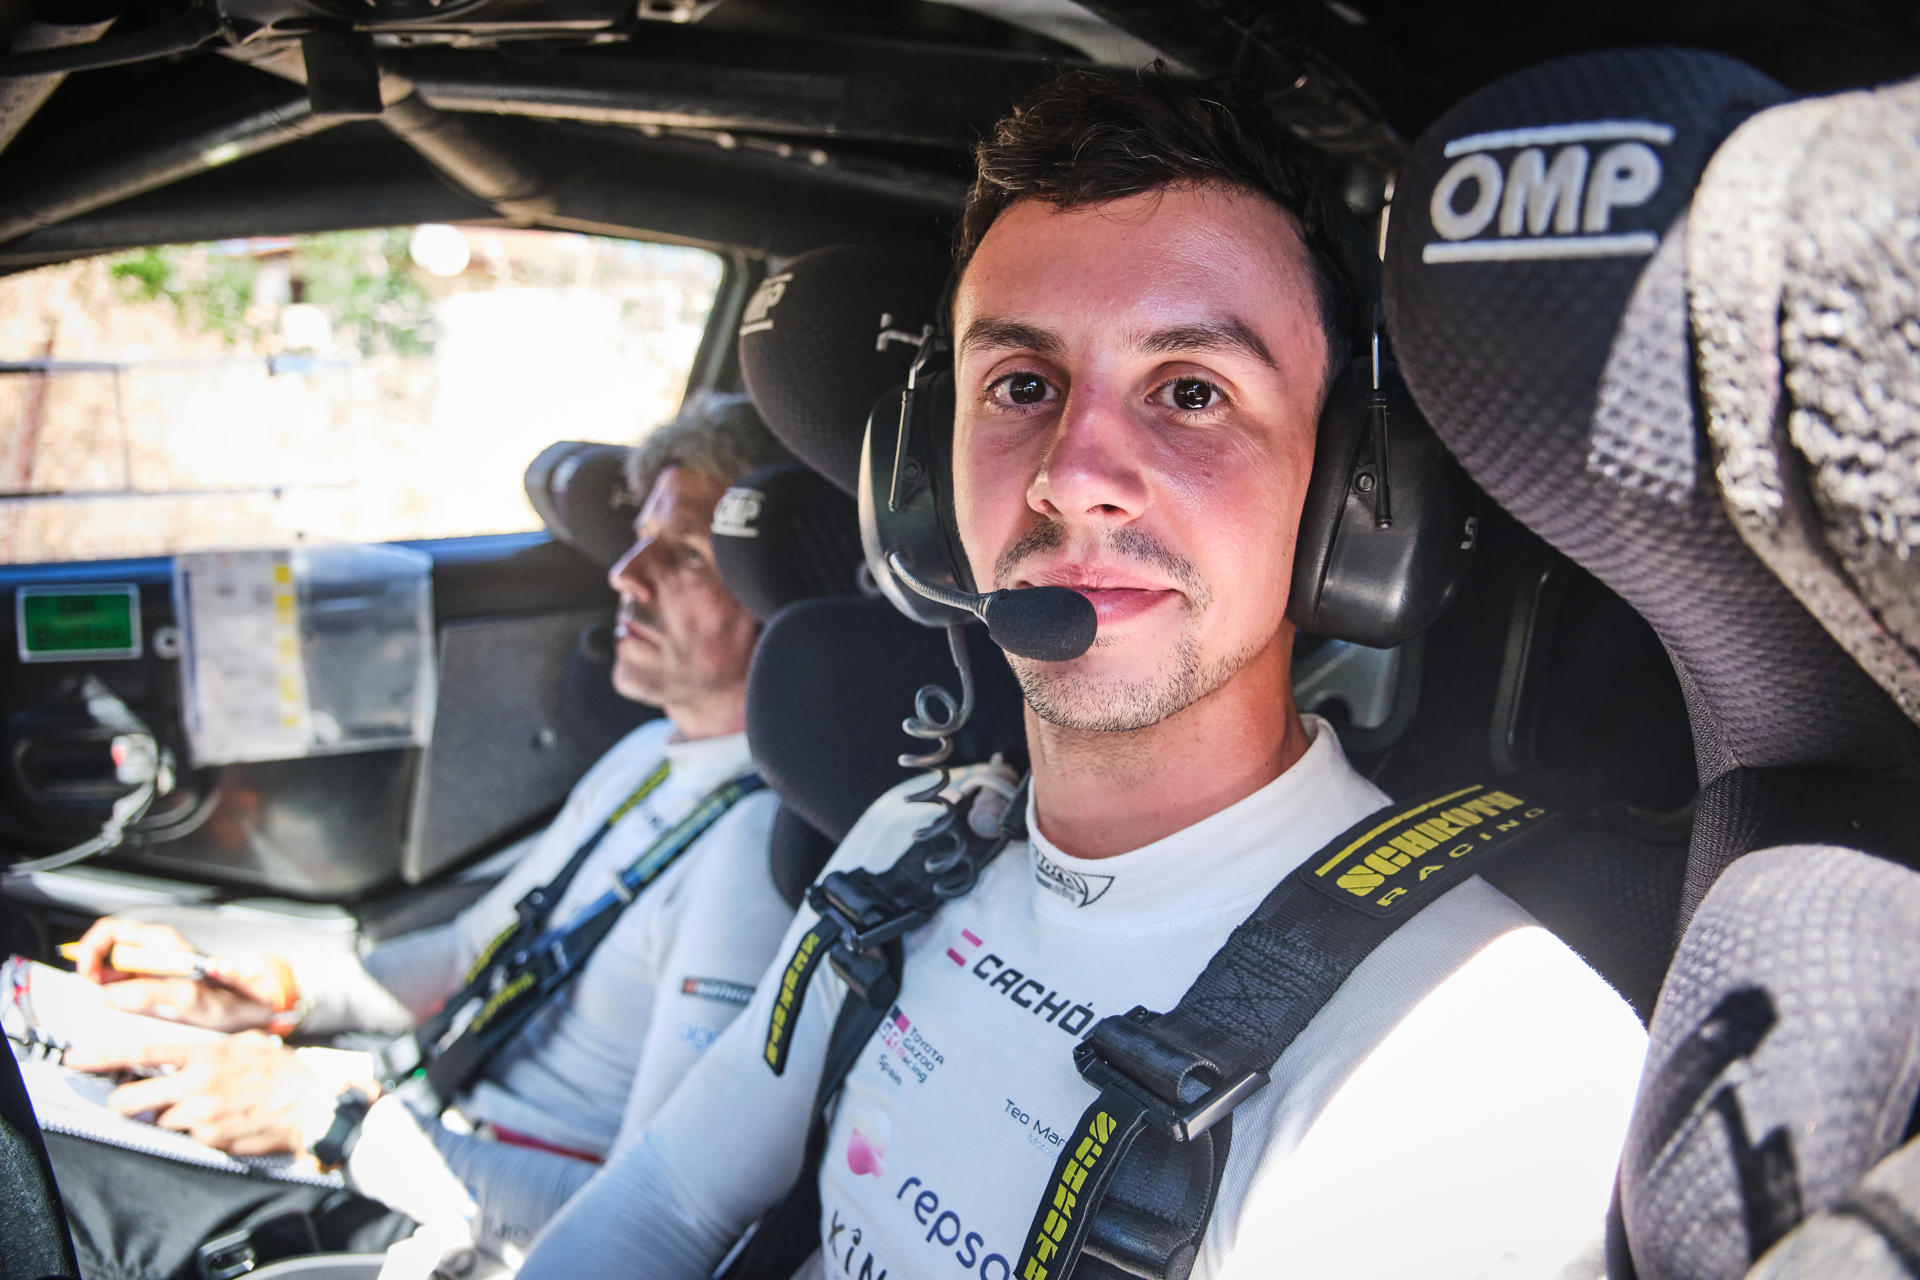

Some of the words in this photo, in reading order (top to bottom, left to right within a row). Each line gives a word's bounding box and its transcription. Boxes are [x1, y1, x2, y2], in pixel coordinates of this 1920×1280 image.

[1430, 141, 1663, 240] OMP
[1336, 791, 1524, 896] SCHROTH
[1376, 808, 1545, 906] RACING
[972, 953, 1100, 1040] CACHÓ
[1003, 1098, 1030, 1125] Teo
[1032, 1119, 1067, 1148] Mar
[896, 1176, 1011, 1280] repso
[1022, 1111, 1117, 1280] SCHROTH
